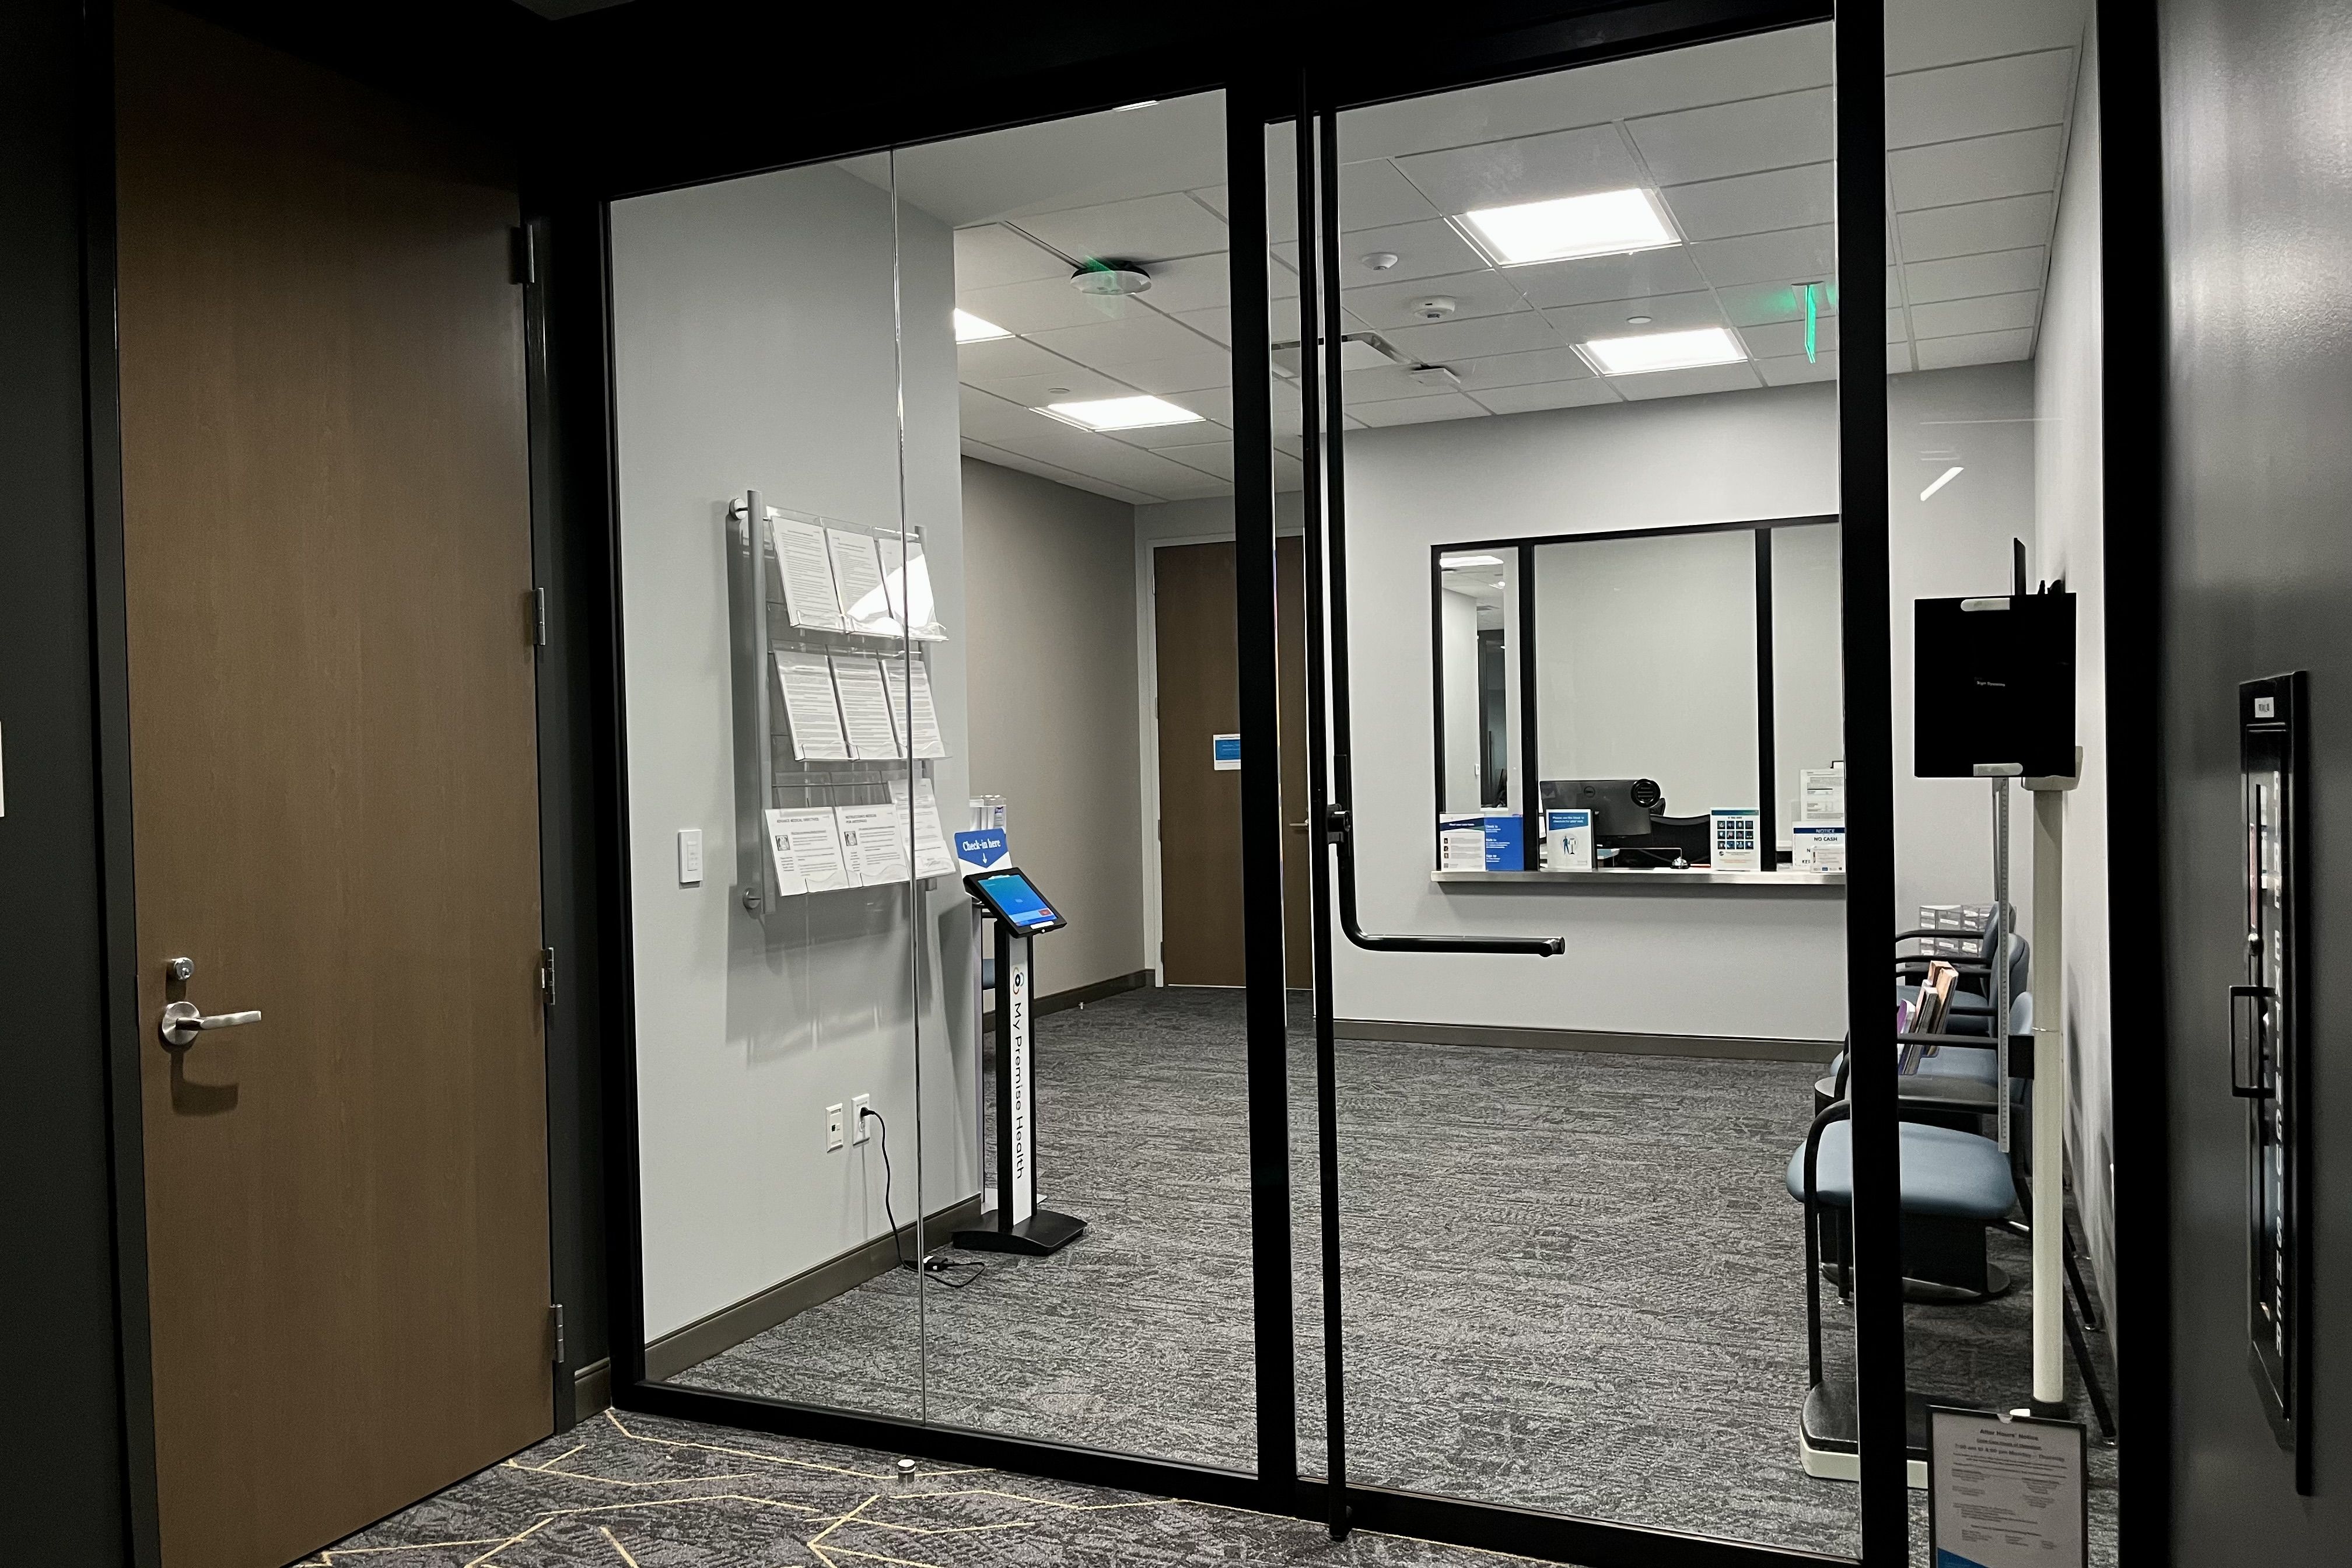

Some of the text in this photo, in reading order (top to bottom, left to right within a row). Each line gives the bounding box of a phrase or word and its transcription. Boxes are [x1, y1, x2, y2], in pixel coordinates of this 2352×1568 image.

[963, 838, 1001, 852] Check-in here
[1013, 1002, 1021, 1030] My
[1015, 1035, 1023, 1111] Premise
[2018, 1433, 2039, 1441] Notice
